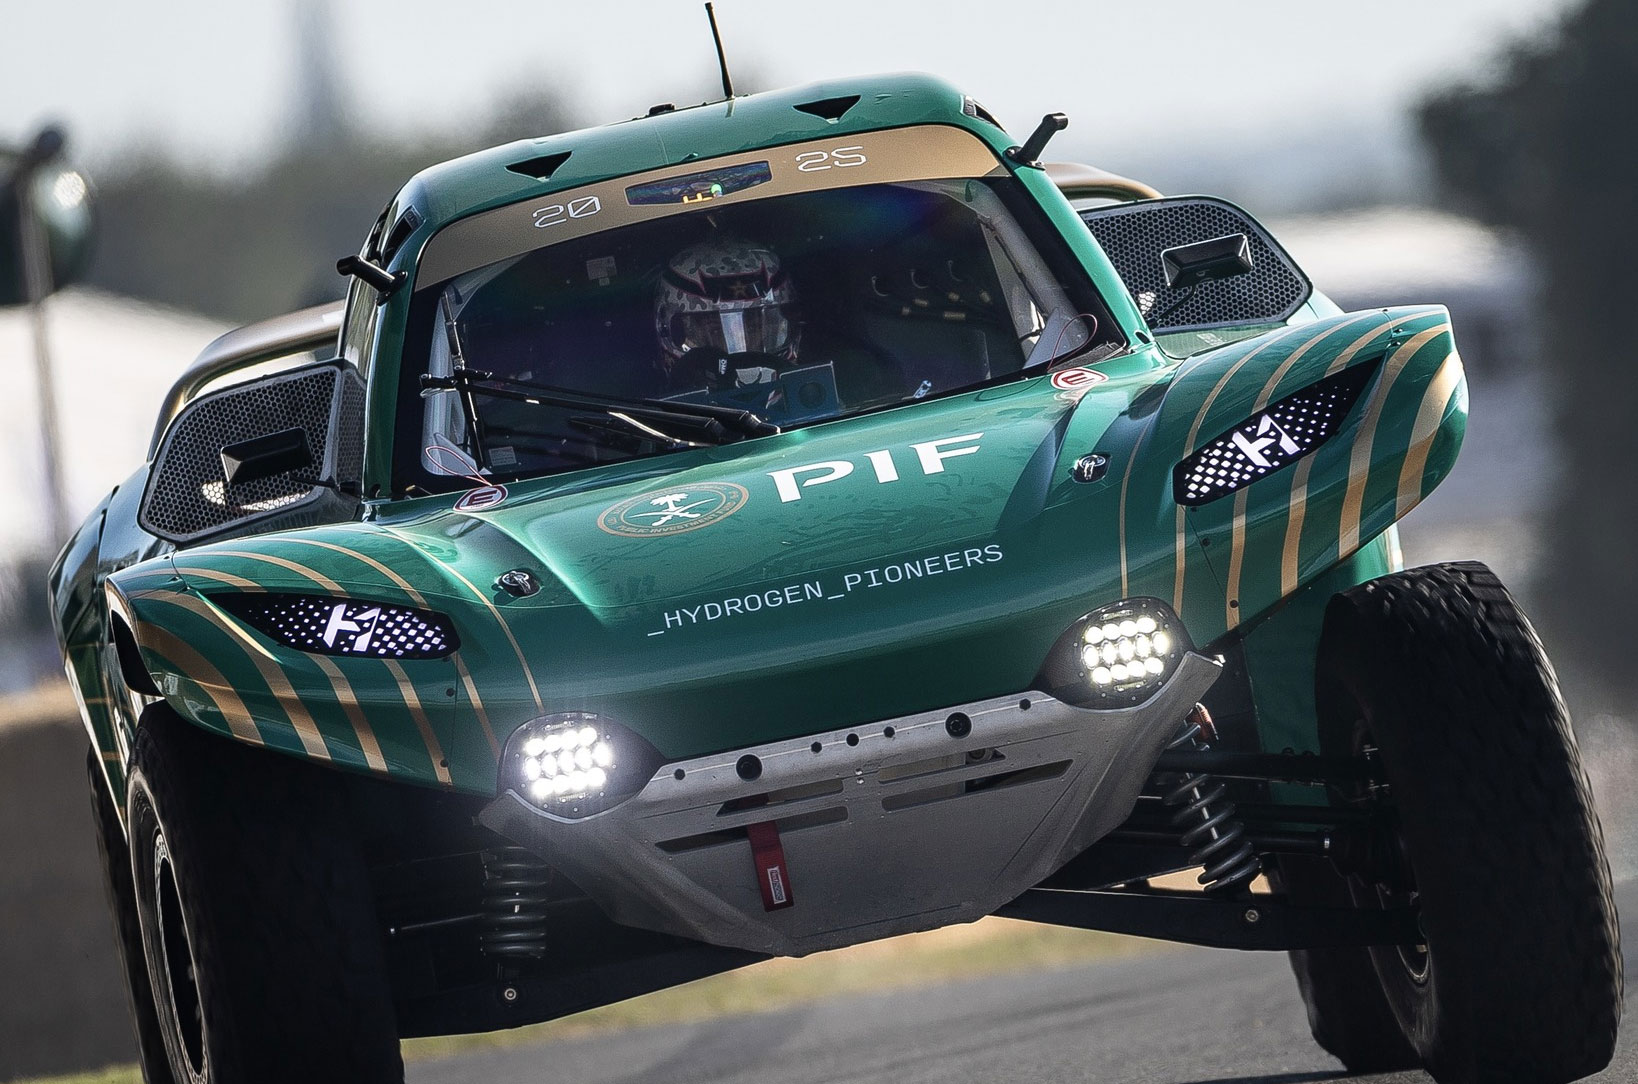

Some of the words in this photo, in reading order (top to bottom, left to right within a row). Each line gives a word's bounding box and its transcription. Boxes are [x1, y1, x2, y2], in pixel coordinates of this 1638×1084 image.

[532, 195, 601, 228] 20
[795, 146, 867, 172] 25
[766, 432, 985, 503] PIF
